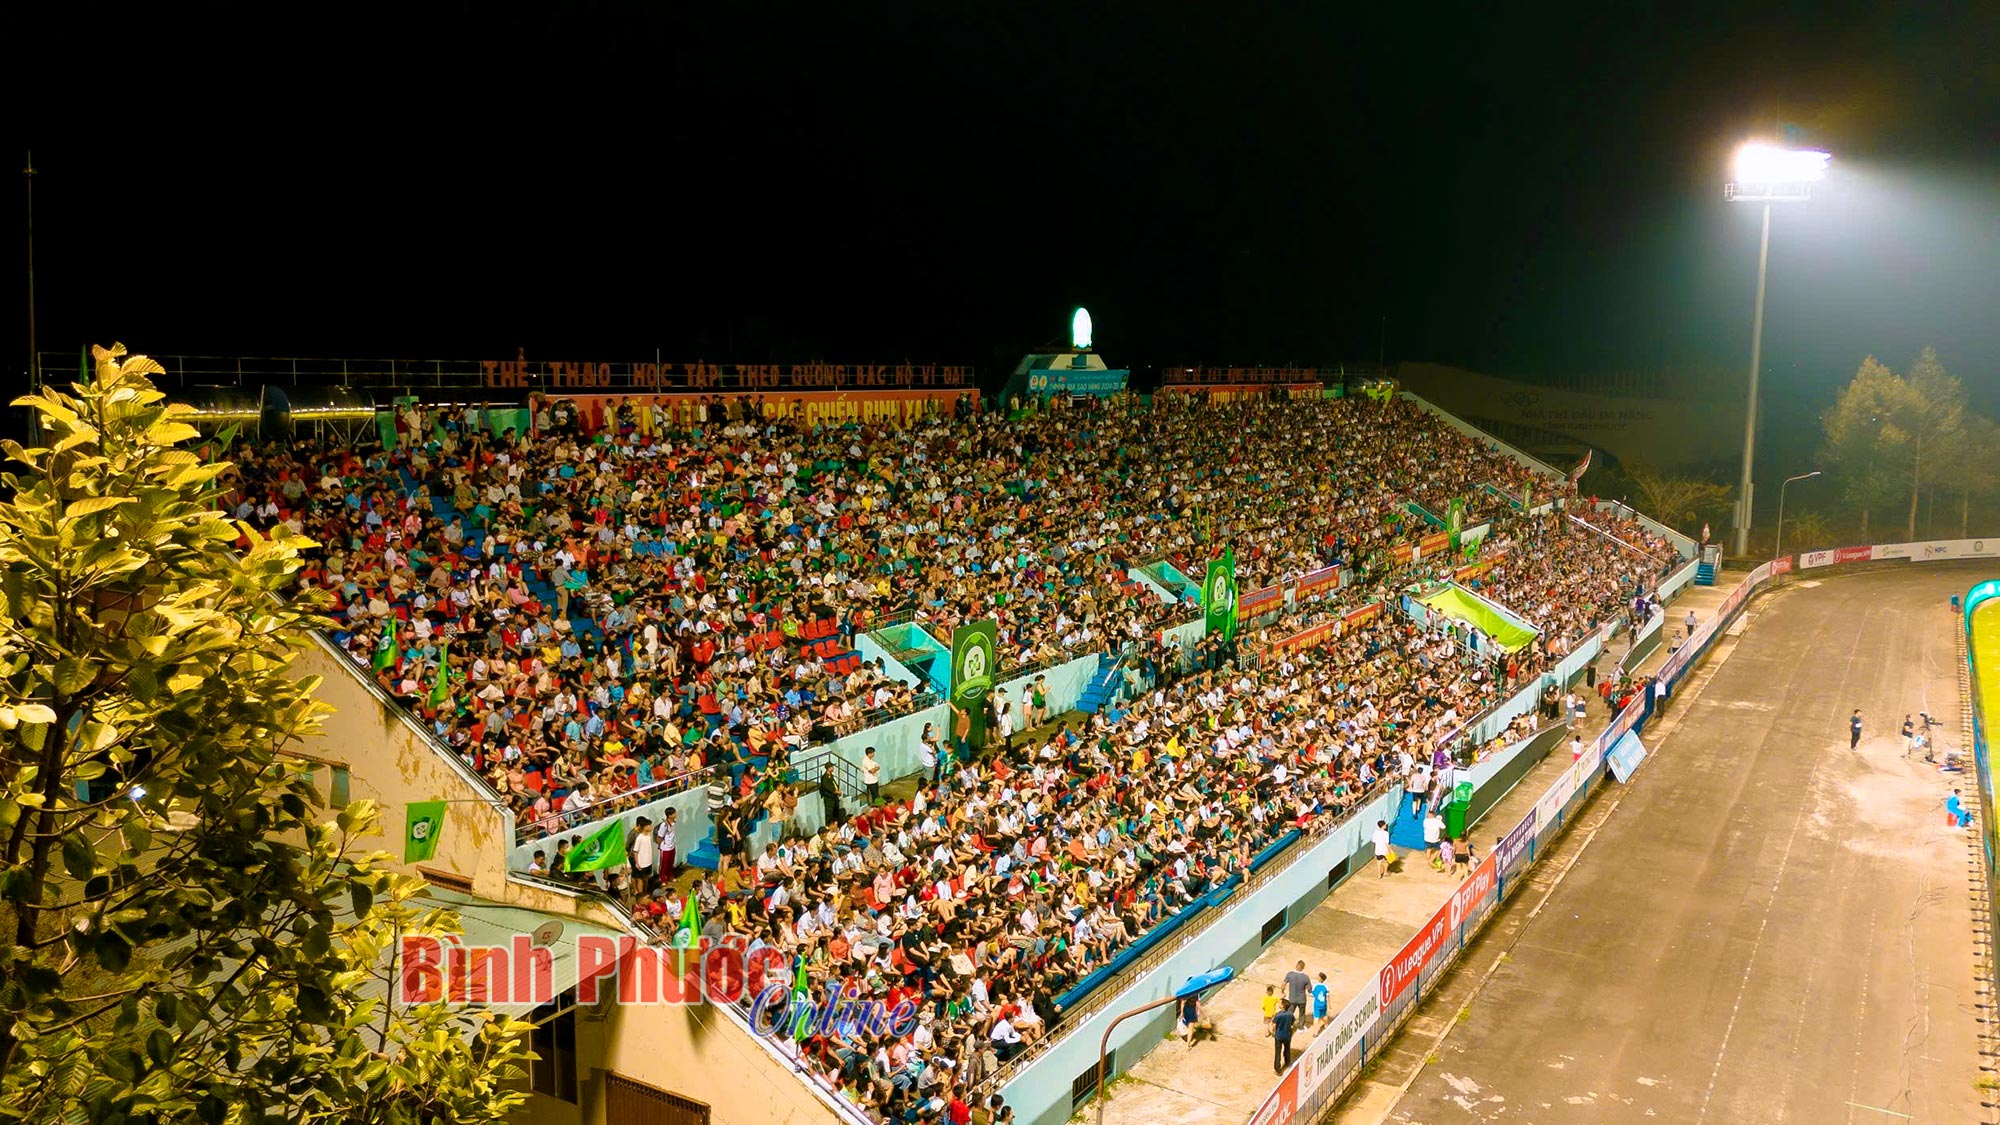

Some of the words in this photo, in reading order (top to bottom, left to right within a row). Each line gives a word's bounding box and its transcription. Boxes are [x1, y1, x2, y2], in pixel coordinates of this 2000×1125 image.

[547, 361, 611, 388] THAO
[632, 362, 673, 390] HỌC
[684, 358, 720, 390] TẬP
[735, 363, 780, 388] THEO
[856, 360, 887, 386] BÁC
[1461, 882, 1476, 912] FPT
[1475, 870, 1490, 897] Play
[1396, 916, 1445, 982] V.League.VPF
[1354, 993, 1378, 1034] SCHOOL
